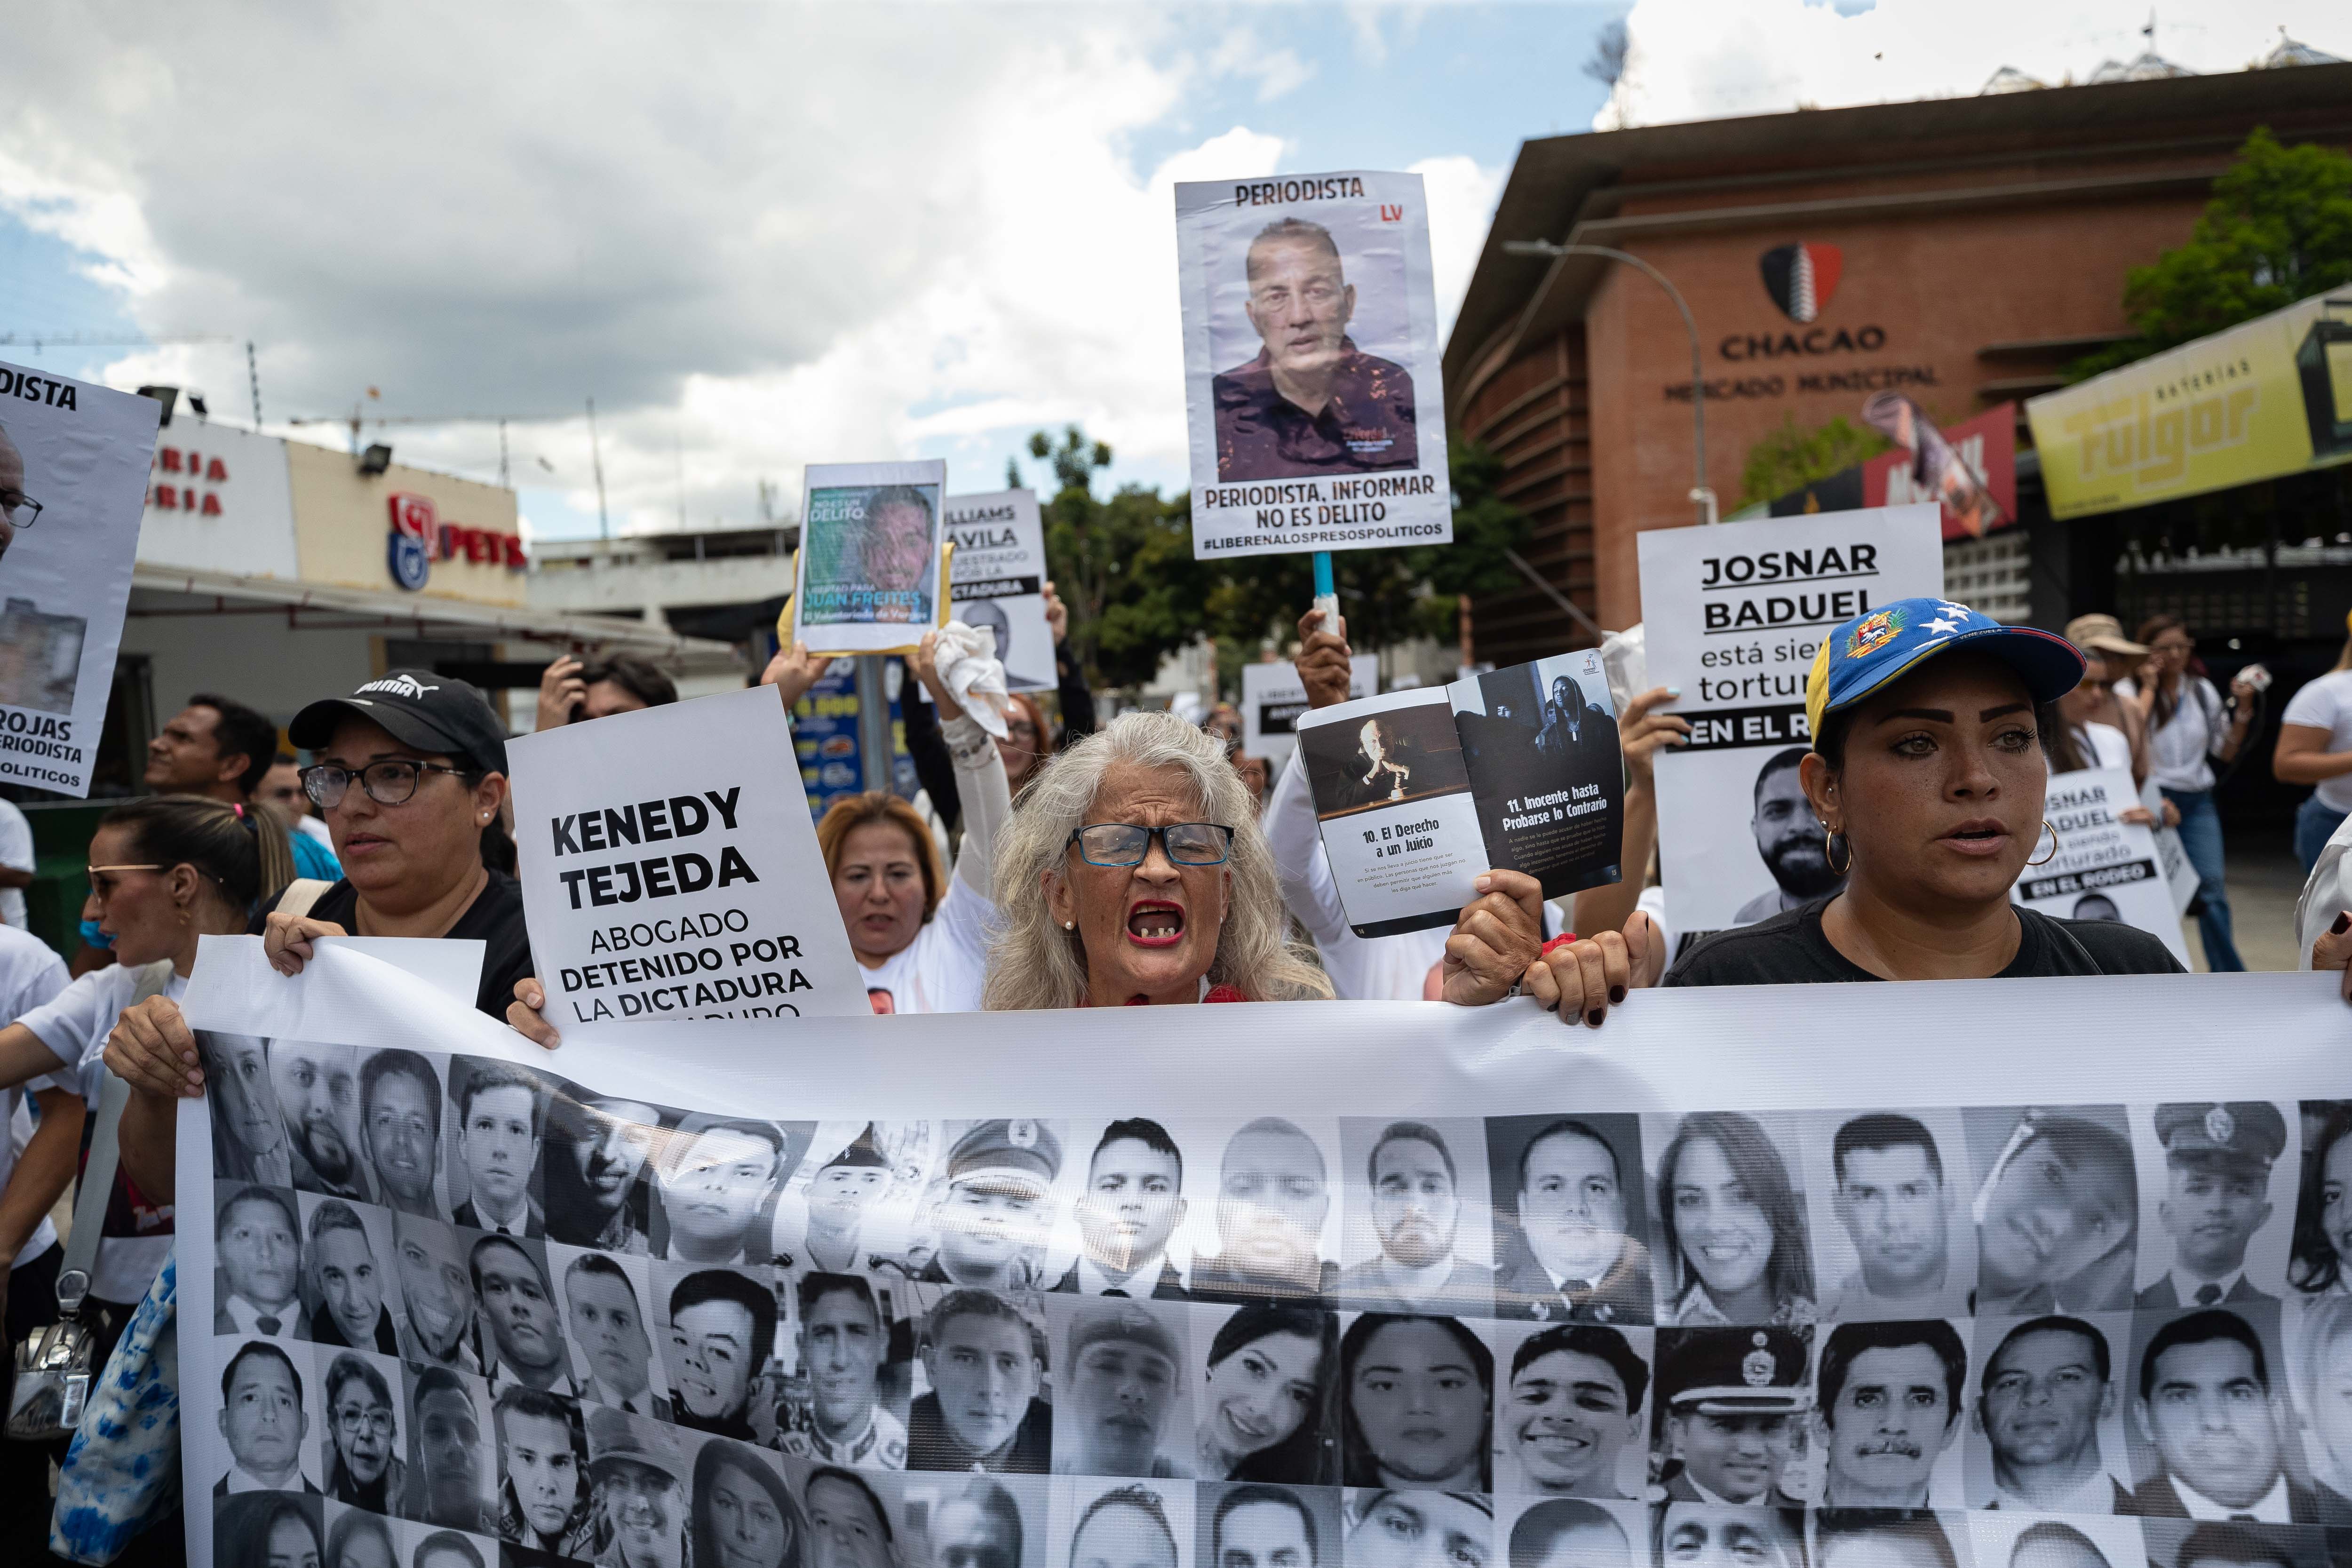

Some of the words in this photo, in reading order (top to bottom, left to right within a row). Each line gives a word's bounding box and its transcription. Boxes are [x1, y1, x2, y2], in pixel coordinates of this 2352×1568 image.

[1235, 177, 1365, 207] PERIODISTA
[1380, 204, 1403, 222] LV
[1720, 325, 1886, 361] CHACAO
[1664, 375, 1786, 402] MERCADO
[1796, 367, 1937, 394] MUNICIPAL
[151, 447, 228, 481] RIA
[1333, 474, 1435, 501] INFORMAR
[810, 507, 865, 522] DELITO
[1257, 508, 1284, 528] NO
[1291, 507, 1311, 526] ES
[1319, 502, 1386, 525] DELITO
[1204, 524, 1443, 550] #LIBERENALOSPRESOSPOLITICOS
[1702, 544, 1876, 585] JOSNAR
[805, 593, 847, 609] JUAN
[851, 591, 922, 606] FREITES
[1705, 589, 1874, 629] BADUEL
[1959, 629, 2002, 640] VENEZUELA
[1701, 642, 1763, 667] está
[1775, 639, 1821, 662] sie
[354, 679, 415, 698] PUMA
[1691, 719, 1734, 744] EN
[1743, 715, 1782, 740] EL
[0, 734, 81, 764] RIODISTA
[1507, 799, 1522, 812] 11.
[1524, 790, 1568, 810] Inocente
[1572, 784, 1599, 799] hasta
[551, 786, 741, 856] KENEDY
[1502, 812, 1550, 831] Probarse
[1553, 807, 1563, 820] lo
[1566, 797, 1607, 817] Contrario
[1363, 830, 1378, 843] 10.
[1382, 827, 1391, 840] El
[1396, 818, 1439, 837] Derecho
[1376, 848, 1383, 858] a
[1388, 844, 1401, 856] un
[1406, 836, 1433, 852] Juicio
[1514, 852, 1533, 860] Cuando
[560, 846, 760, 910] TEJEDA
[1365, 874, 1384, 883] público.
[2031, 880, 2056, 899] EN
[2058, 876, 2080, 892] EL
[591, 908, 749, 954] ABOGADO
[560, 947, 723, 992] DETENIDO
[730, 935, 803, 967] POR
[573, 998, 614, 1023] LA
[617, 968, 814, 1017] DICTADURA
